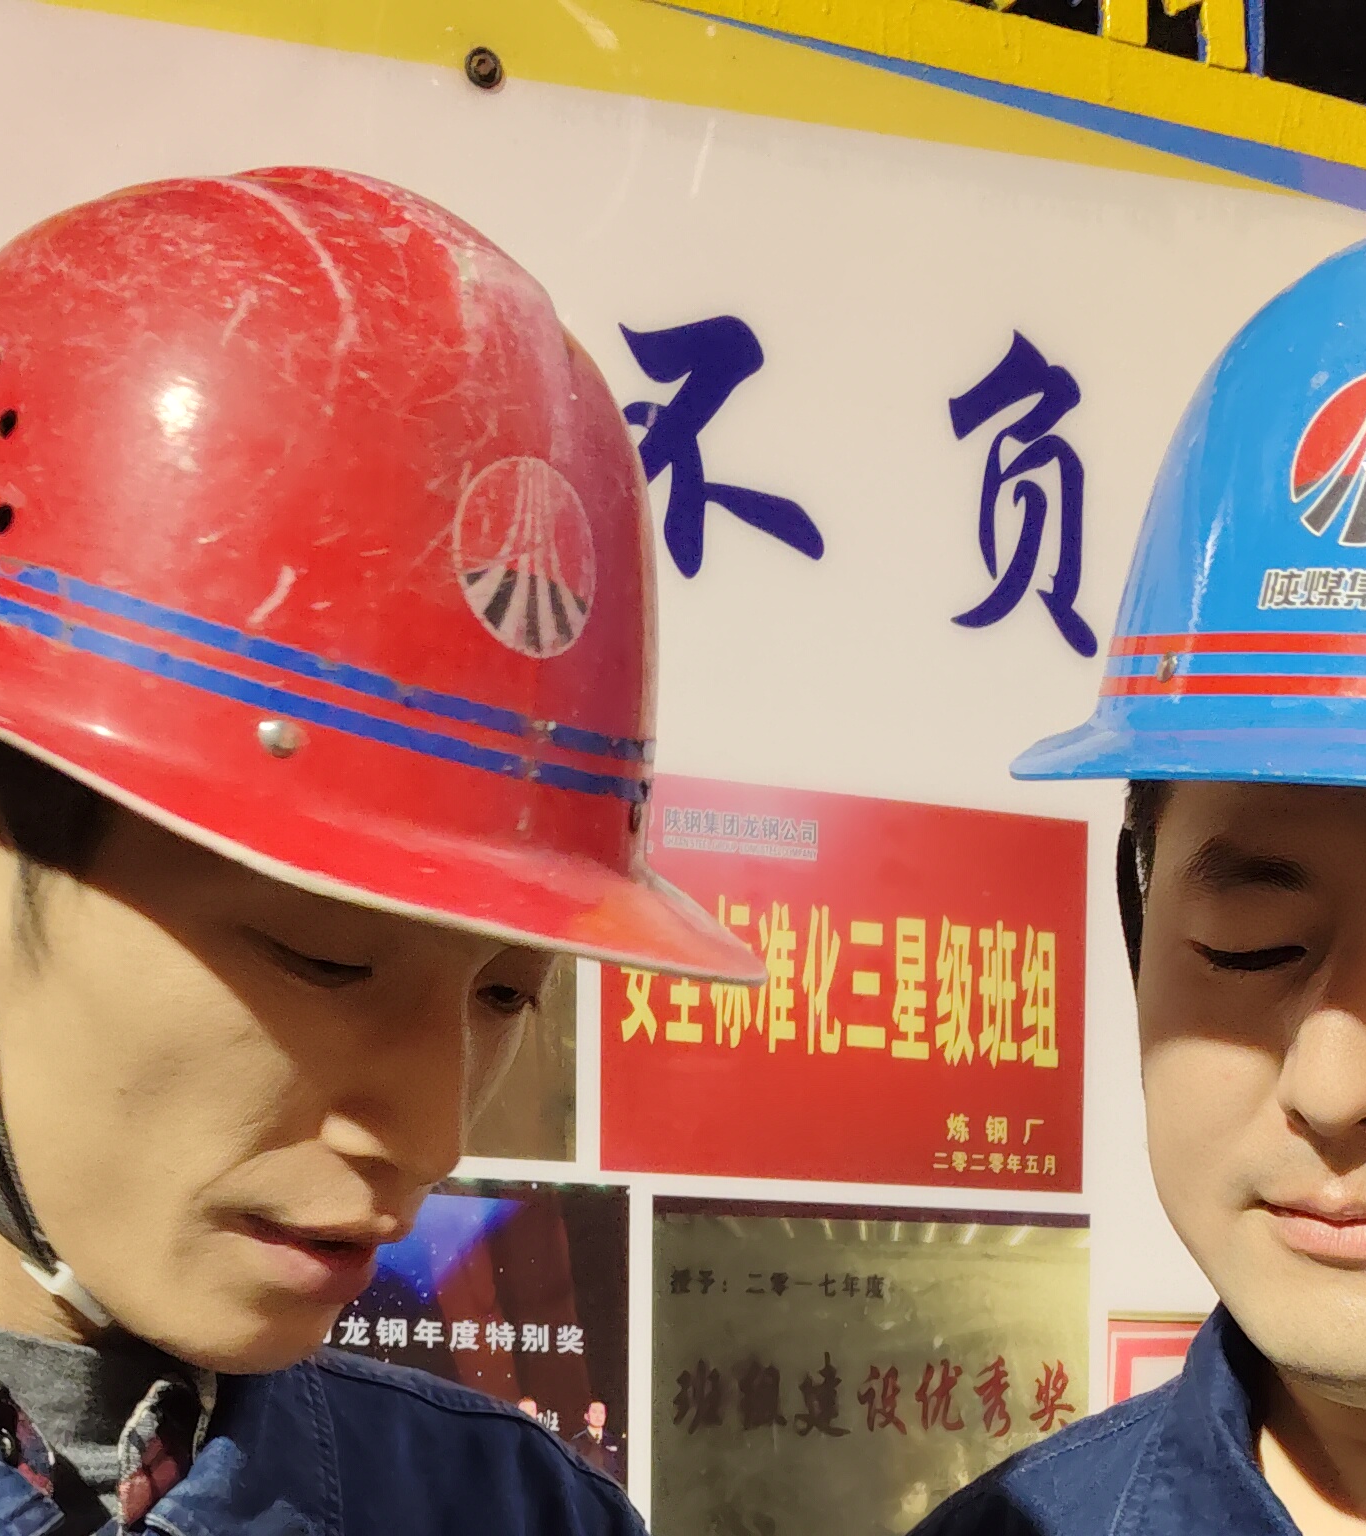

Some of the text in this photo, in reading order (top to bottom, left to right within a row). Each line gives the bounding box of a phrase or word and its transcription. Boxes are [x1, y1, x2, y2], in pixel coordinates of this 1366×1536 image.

[664, 807, 819, 844] 陕钢集团龙钢公司
[946, 1112, 1045, 1145] 炼钢厂
[933, 1151, 1056, 1176] 二零二零年五月
[322, 1315, 585, 1355] 龙钢年度特别奖
